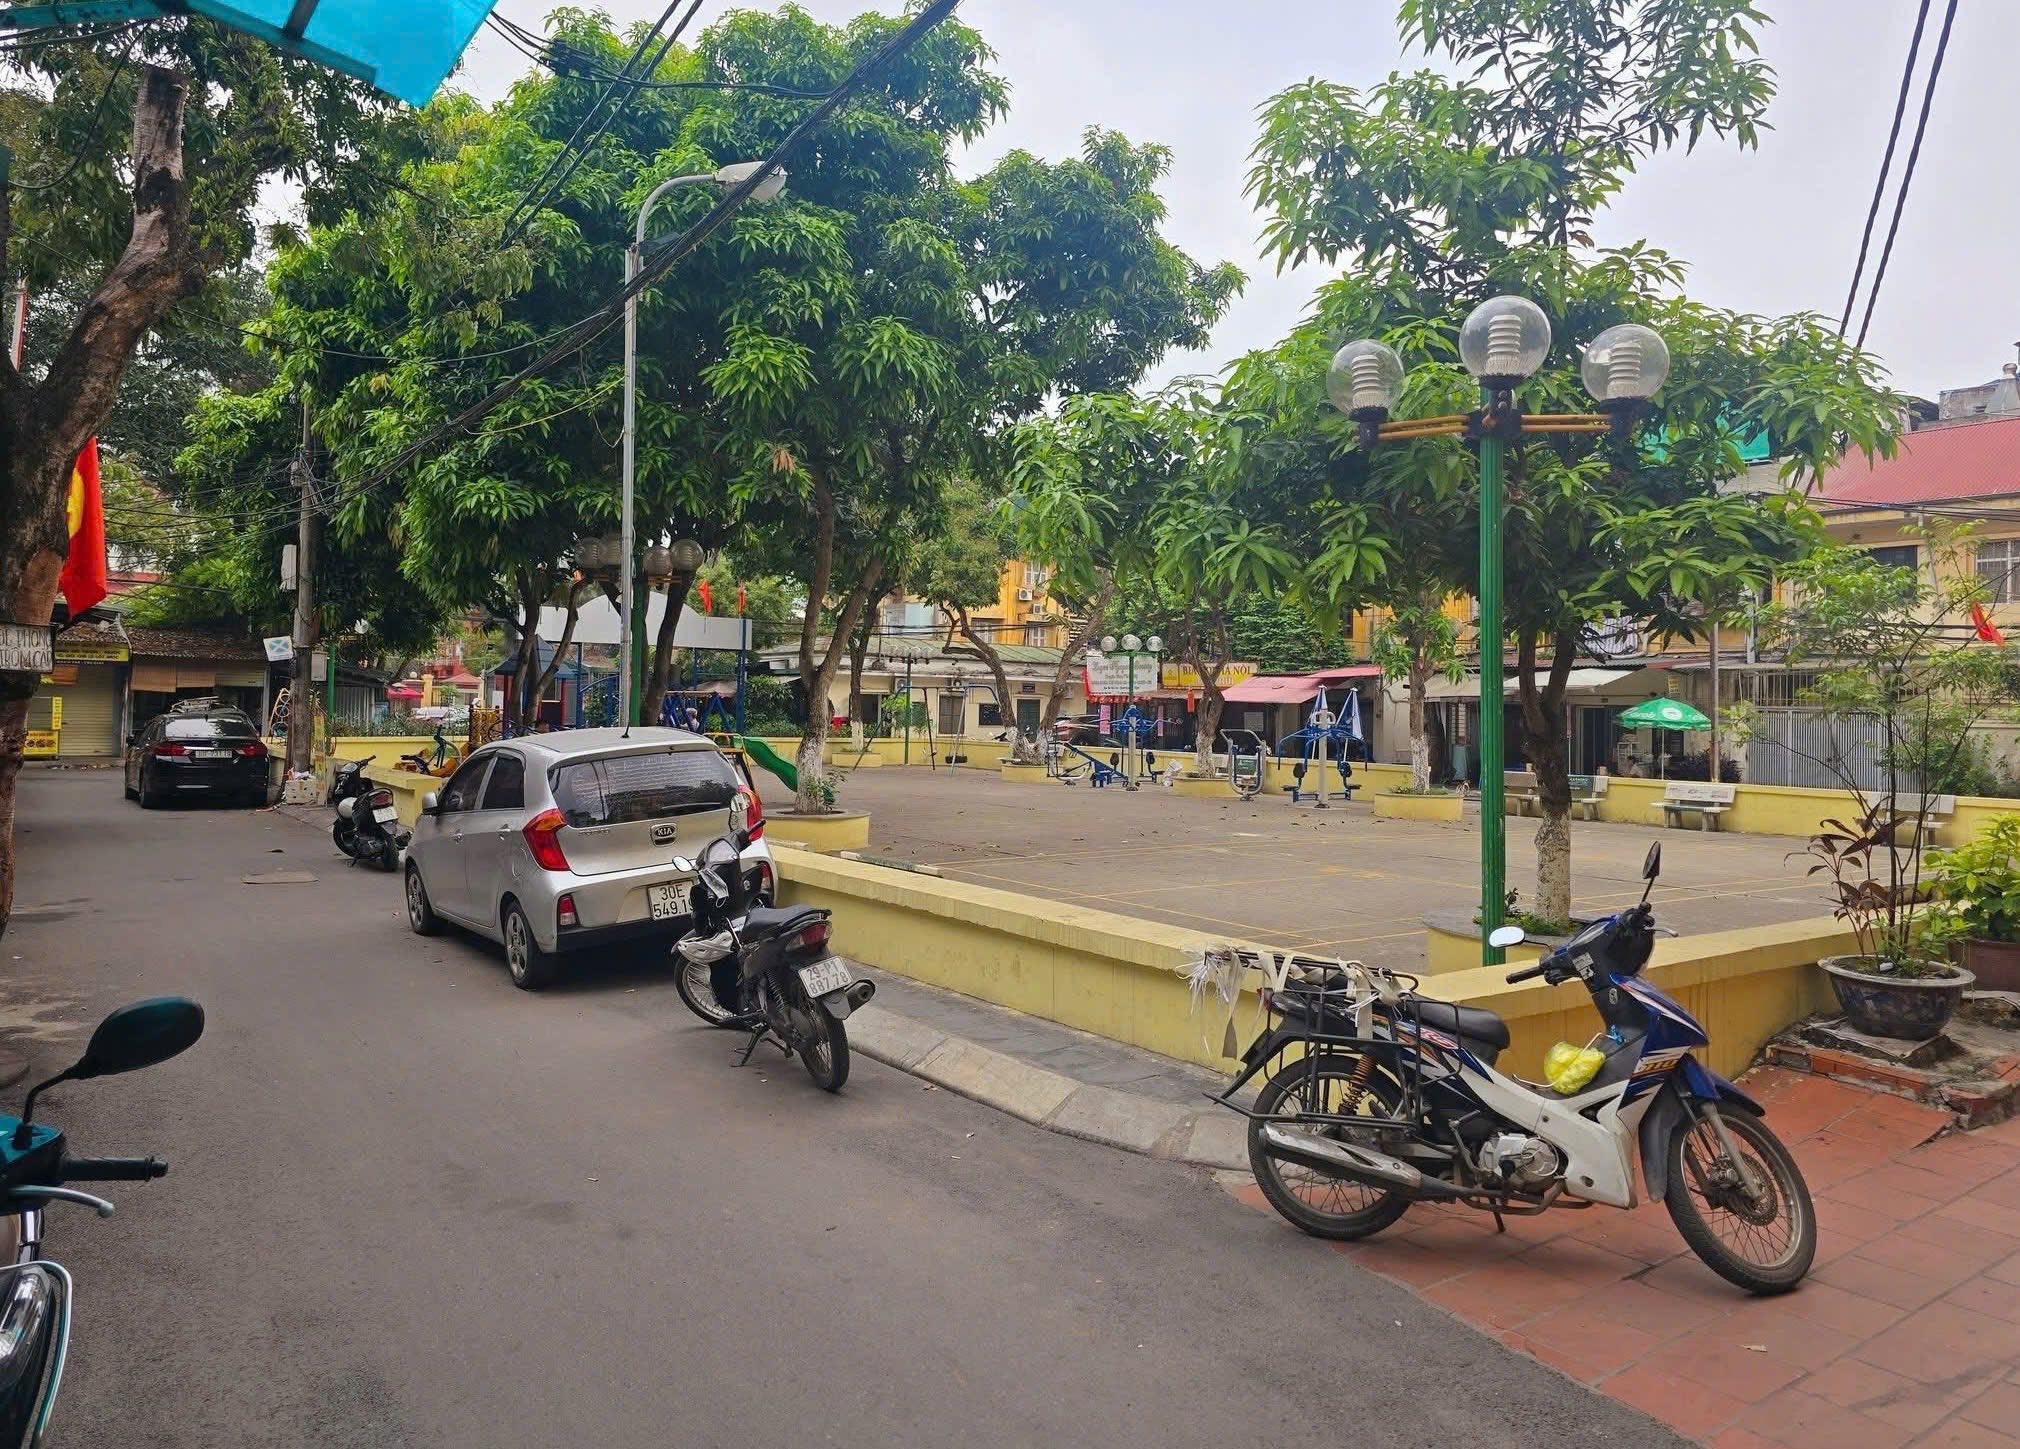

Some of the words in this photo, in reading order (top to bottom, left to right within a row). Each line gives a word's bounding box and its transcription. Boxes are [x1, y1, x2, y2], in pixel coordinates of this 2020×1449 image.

[657, 827, 673, 836] KIA
[660, 884, 686, 901] 30E
[809, 971, 849, 994] 887.78
